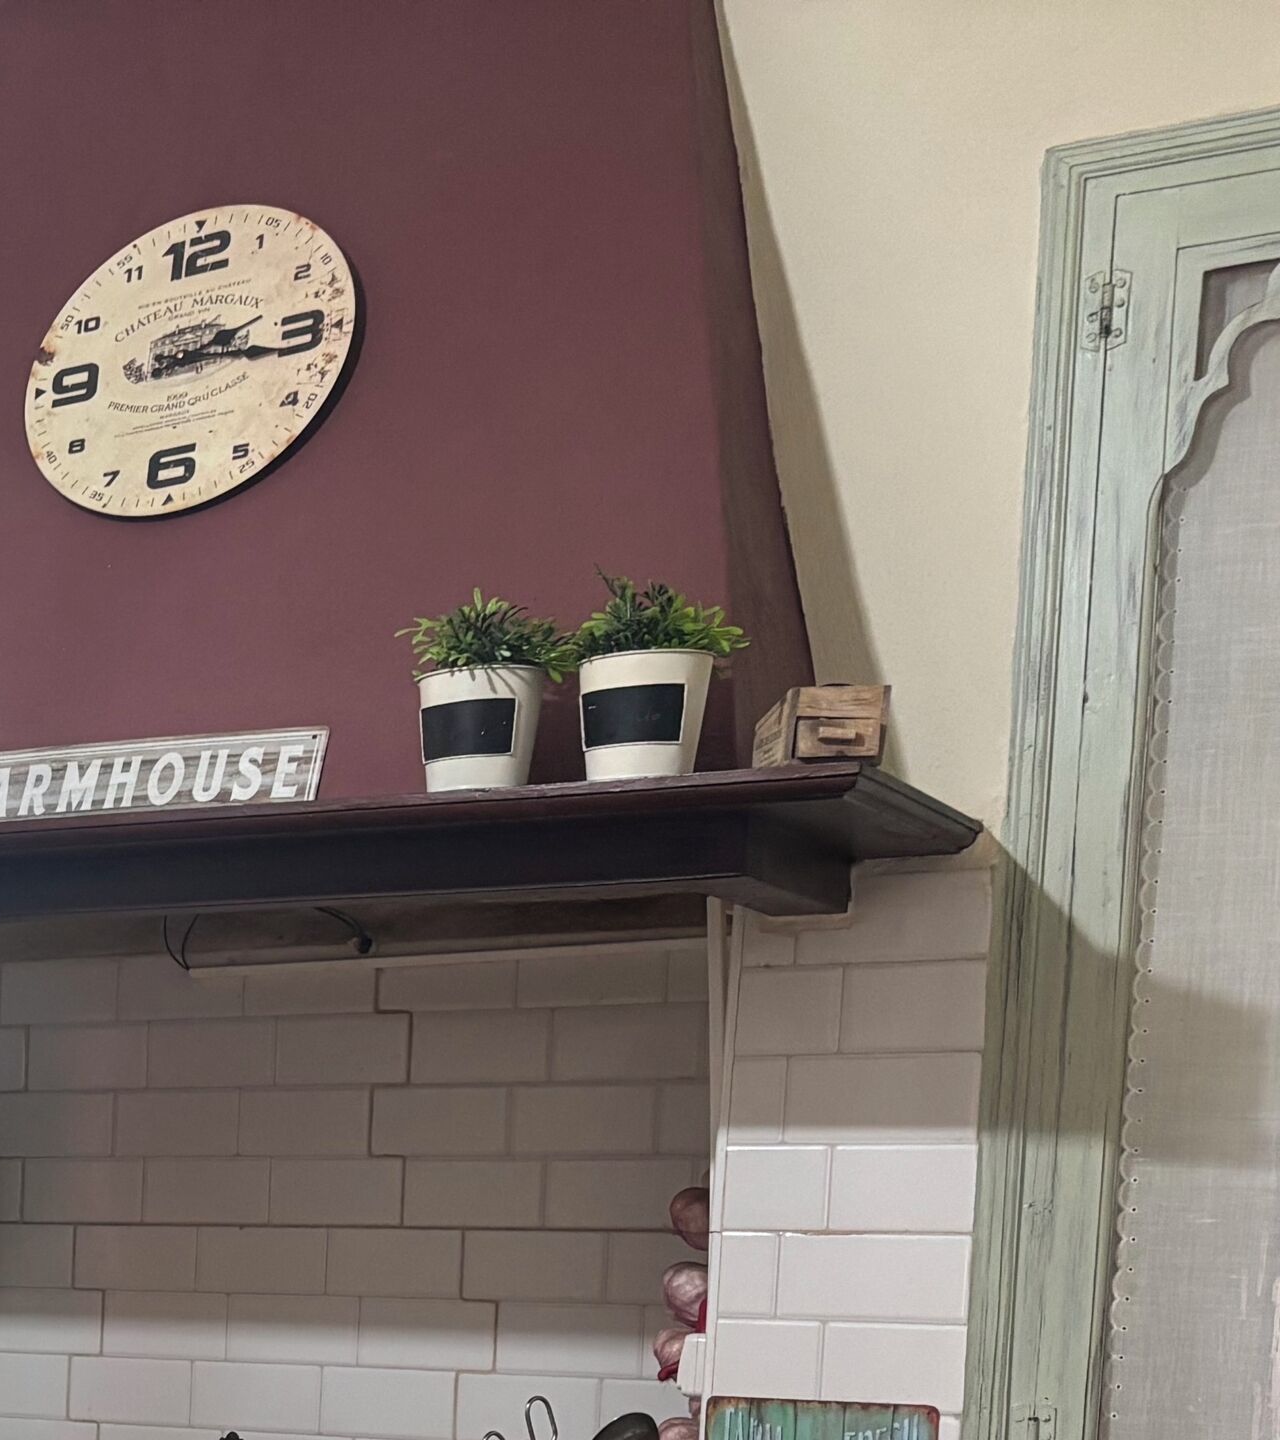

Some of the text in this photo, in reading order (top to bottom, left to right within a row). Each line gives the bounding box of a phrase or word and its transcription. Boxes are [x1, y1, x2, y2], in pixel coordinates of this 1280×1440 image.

[265, 216, 282, 229] 05
[255, 233, 265, 250] 1
[116, 254, 133, 270] 55
[161, 229, 232, 283] 12
[320, 252, 333, 266] 10
[123, 264, 144, 284] 11
[293, 263, 312, 282] 2
[191, 293, 264, 310] MARGAUX
[60, 315, 75, 332] 50
[74, 315, 101, 335] 10
[277, 308, 325, 357] 3
[51, 362, 100, 409] 9
[107, 400, 149, 414] PREMIER
[150, 401, 187, 413] GRAND
[187, 392, 210, 407] CRU
[279, 390, 300, 408] 4
[302, 392, 318, 410] 20
[68, 438, 86, 455] 8
[232, 442, 250, 461] 5
[45, 450, 58, 465] 40
[146, 442, 197, 489] 6
[238, 459, 256, 475] 25
[102, 469, 121, 488] 7
